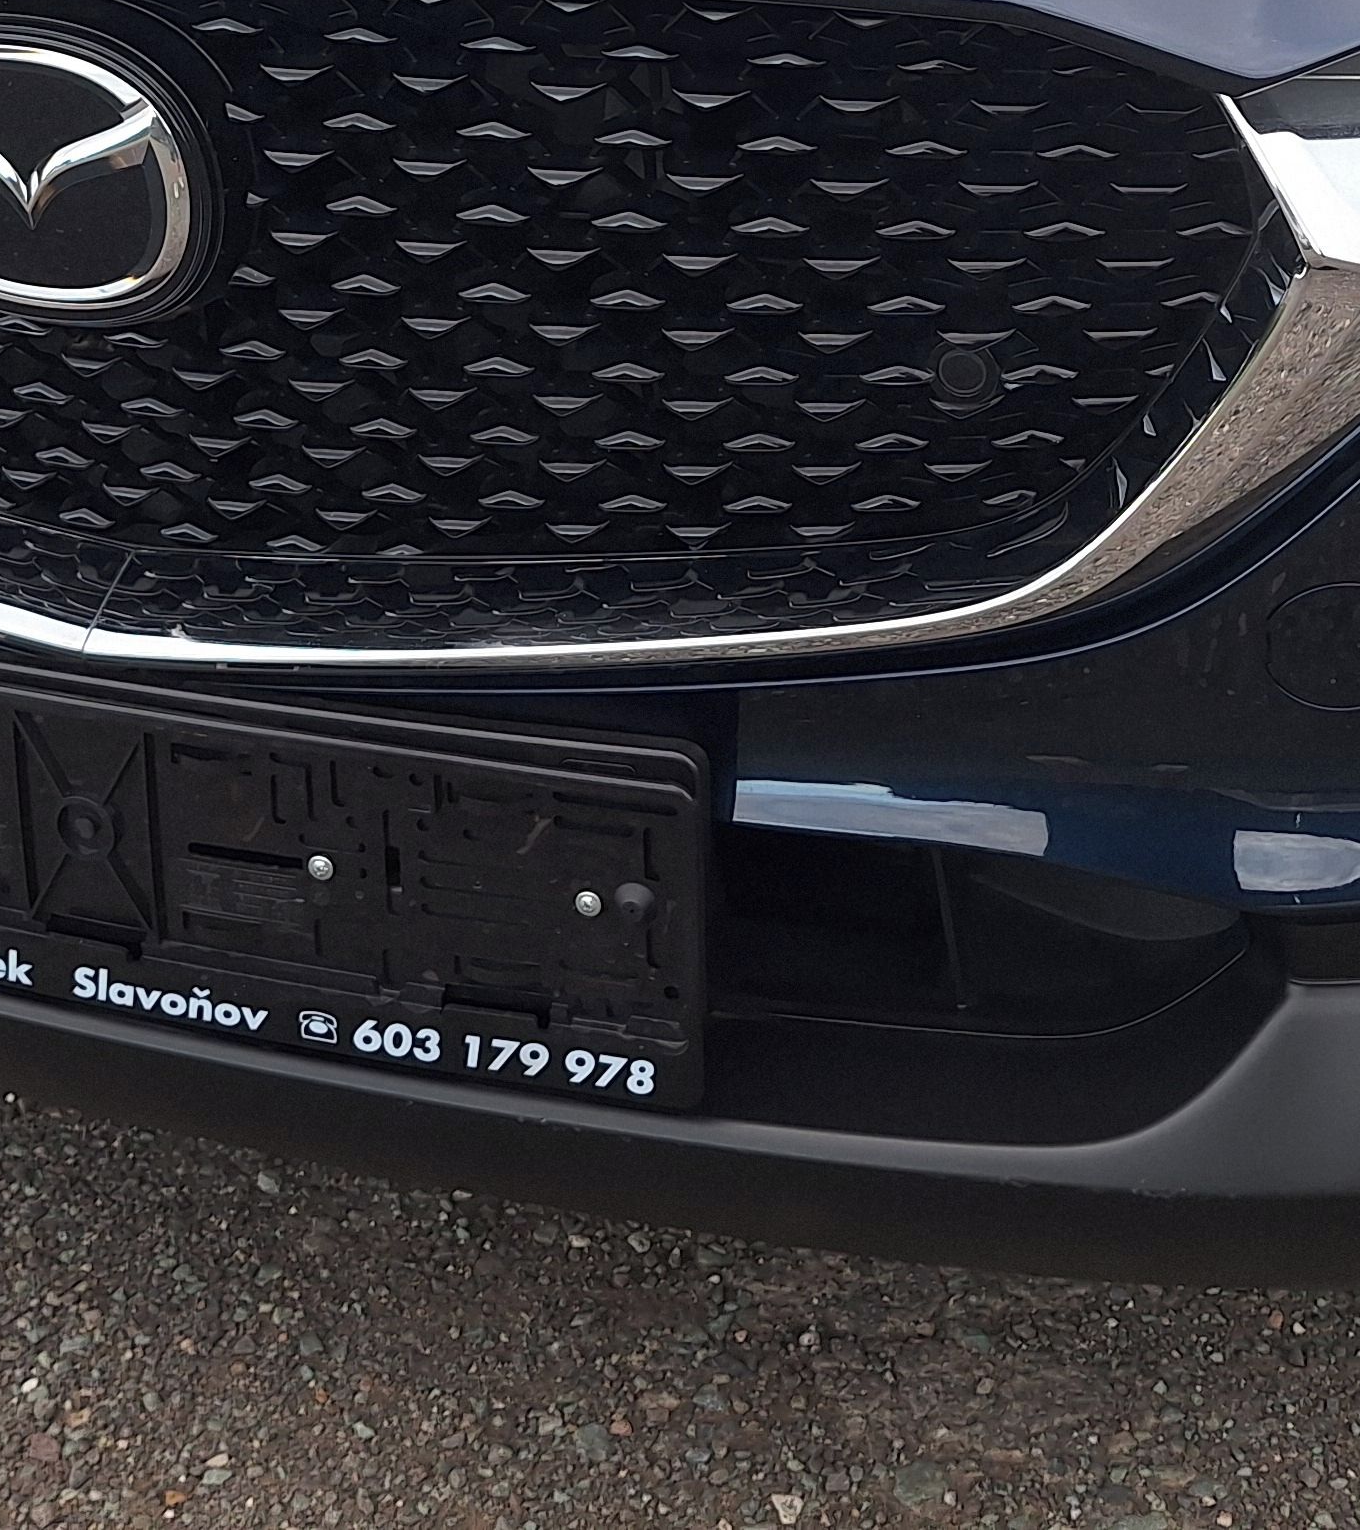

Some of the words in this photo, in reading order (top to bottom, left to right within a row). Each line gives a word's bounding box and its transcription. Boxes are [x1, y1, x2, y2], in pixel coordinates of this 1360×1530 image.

[72, 965, 269, 1031] Slavoňov
[352, 1018, 442, 1063] 603
[463, 1033, 551, 1077] 179
[564, 1048, 656, 1096] 978
